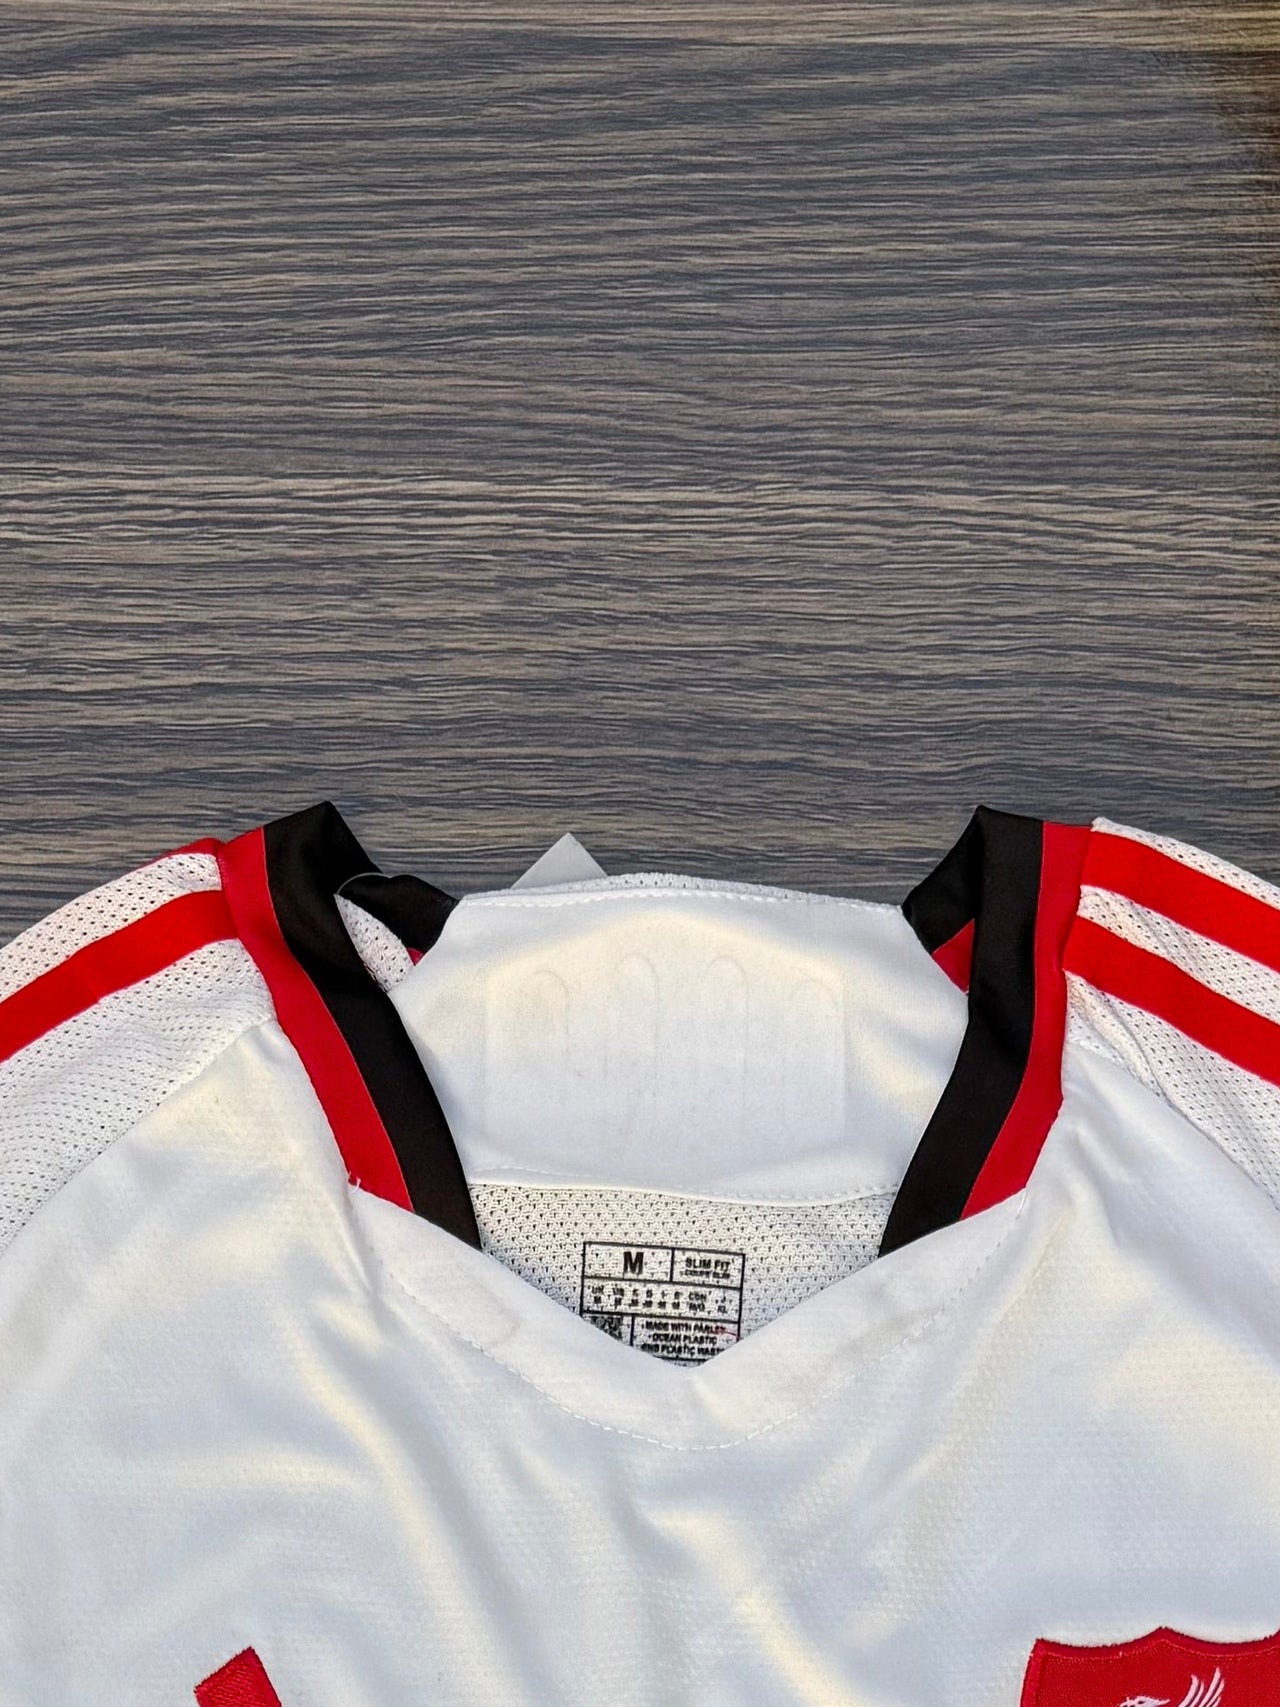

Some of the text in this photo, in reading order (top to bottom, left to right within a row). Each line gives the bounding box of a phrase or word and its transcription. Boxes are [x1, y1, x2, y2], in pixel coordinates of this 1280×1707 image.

[623, 1251, 644, 1275] M
[685, 1257, 731, 1271] SLIM FIT
[670, 1323, 692, 1333] WITH
[652, 1333, 718, 1346] OCEAN PLASTIC
[661, 1344, 696, 1356] PLASTIC
